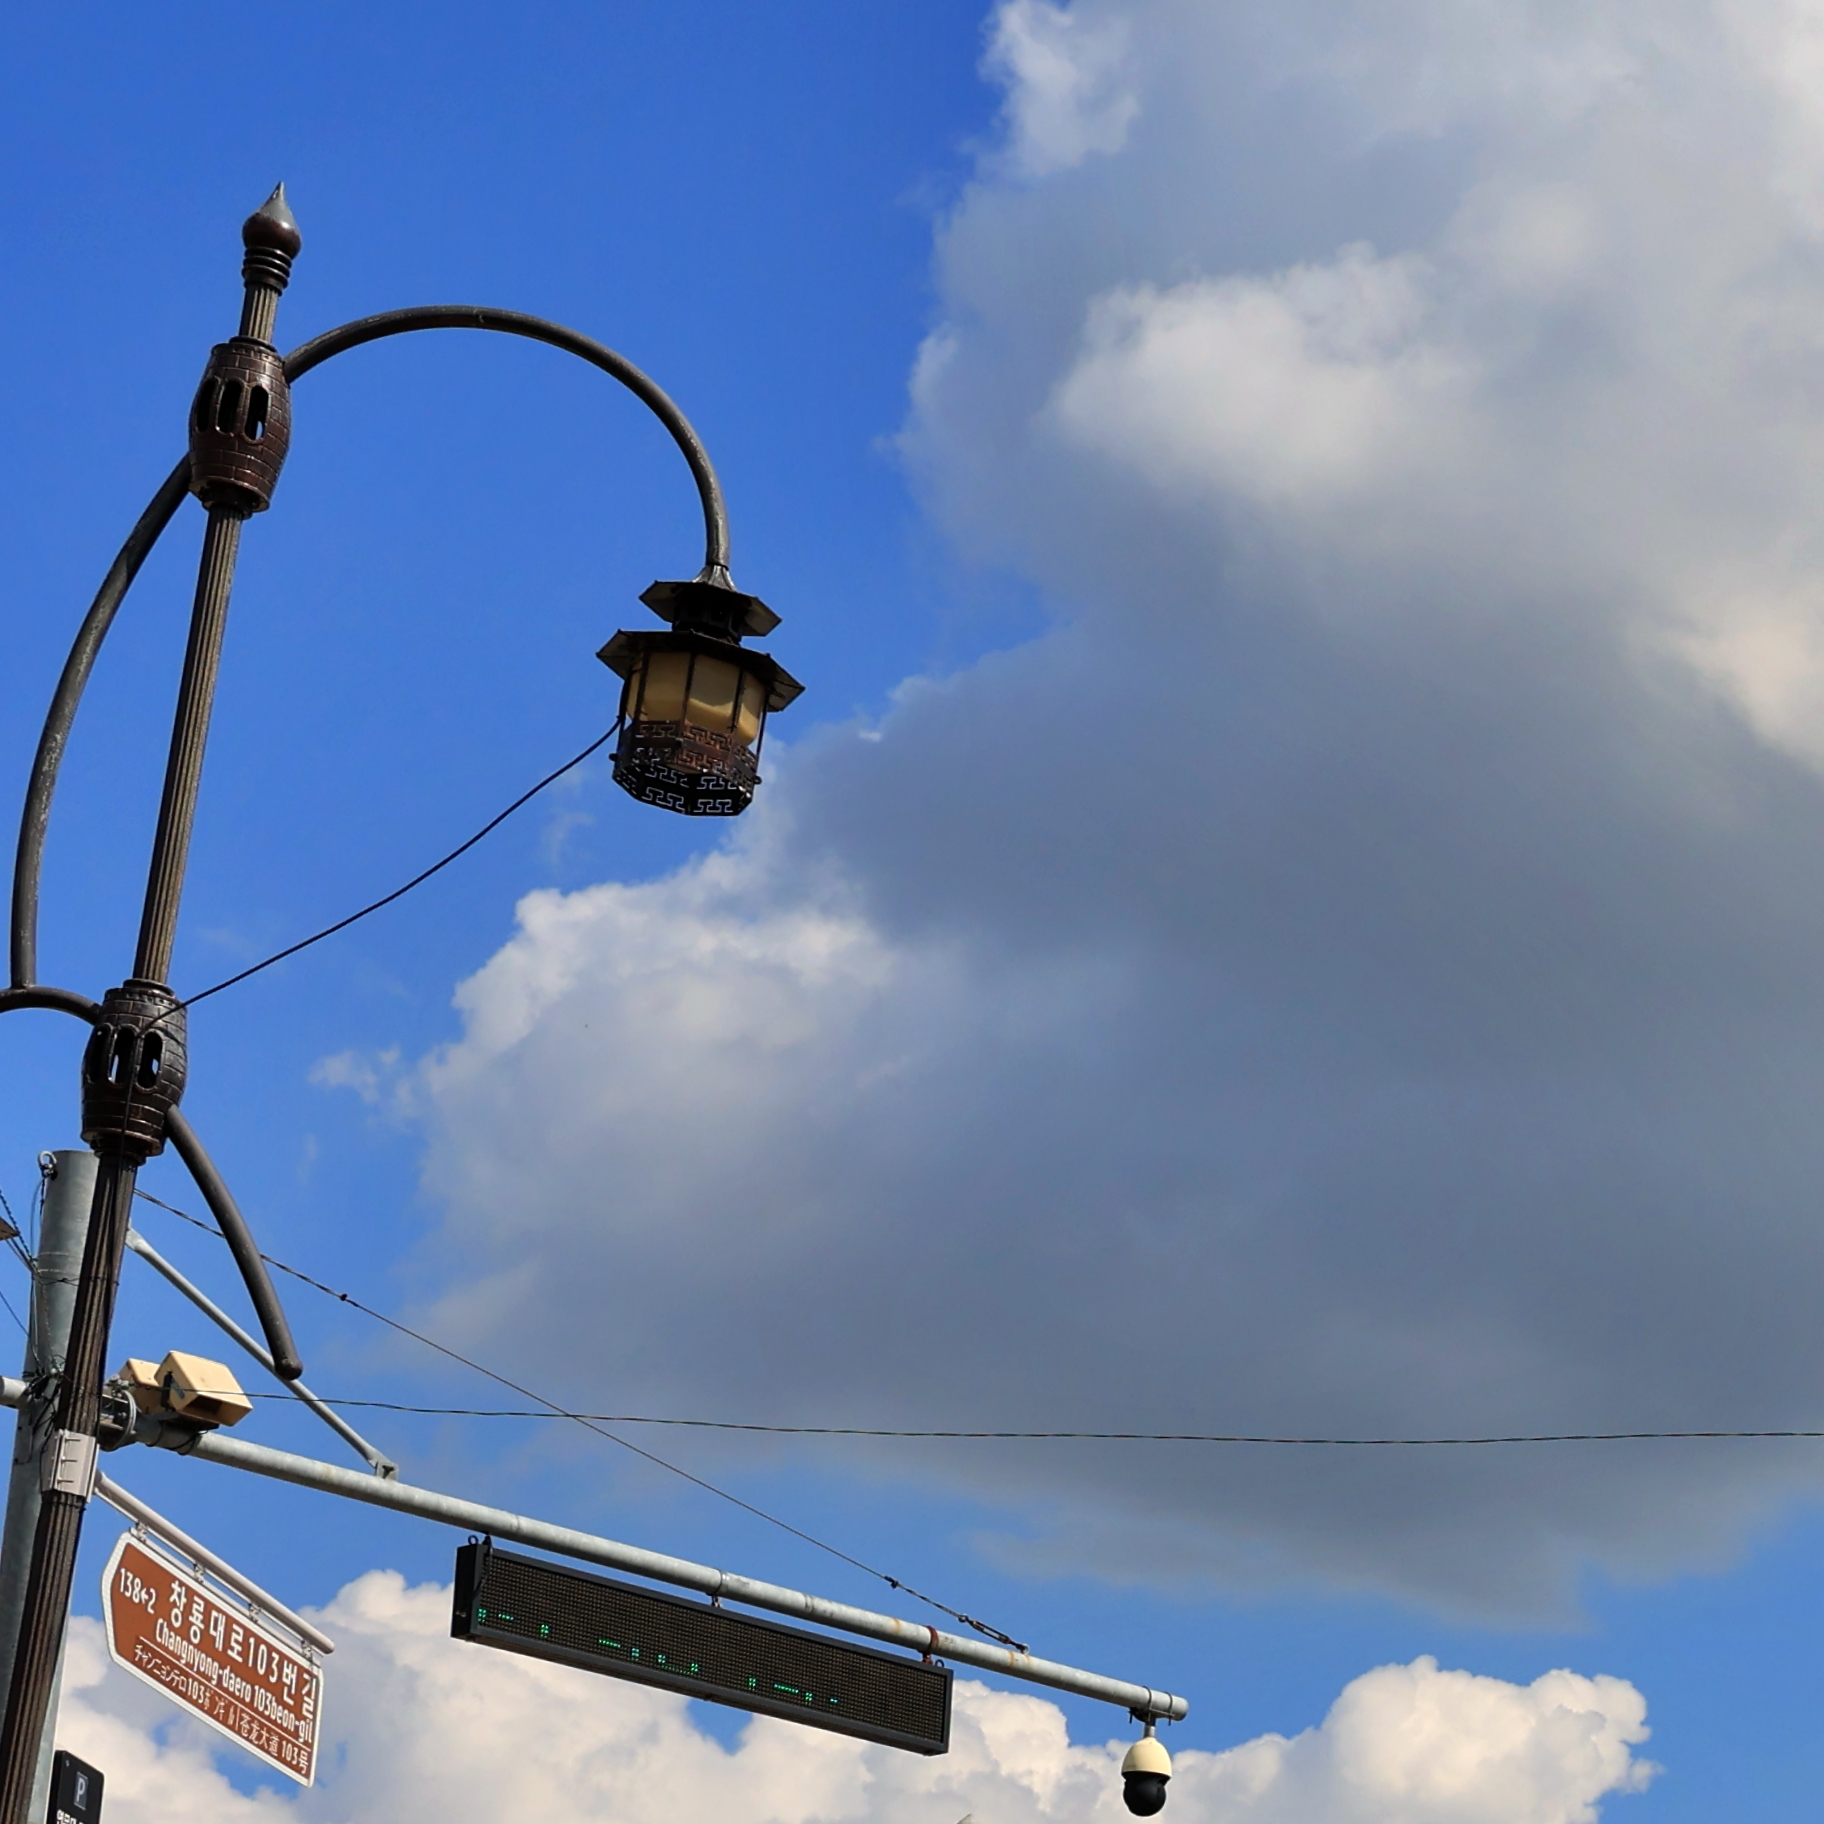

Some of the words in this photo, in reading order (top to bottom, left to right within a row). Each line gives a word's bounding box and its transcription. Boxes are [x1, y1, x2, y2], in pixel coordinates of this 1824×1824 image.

[119, 1568, 142, 1604] 138
[155, 1618, 252, 1703] Changnyong-daero
[253, 1685, 313, 1744] 103beon-gil
[169, 1580, 316, 1719] 창룡대로103번길
[76, 1777, 86, 1803] P
